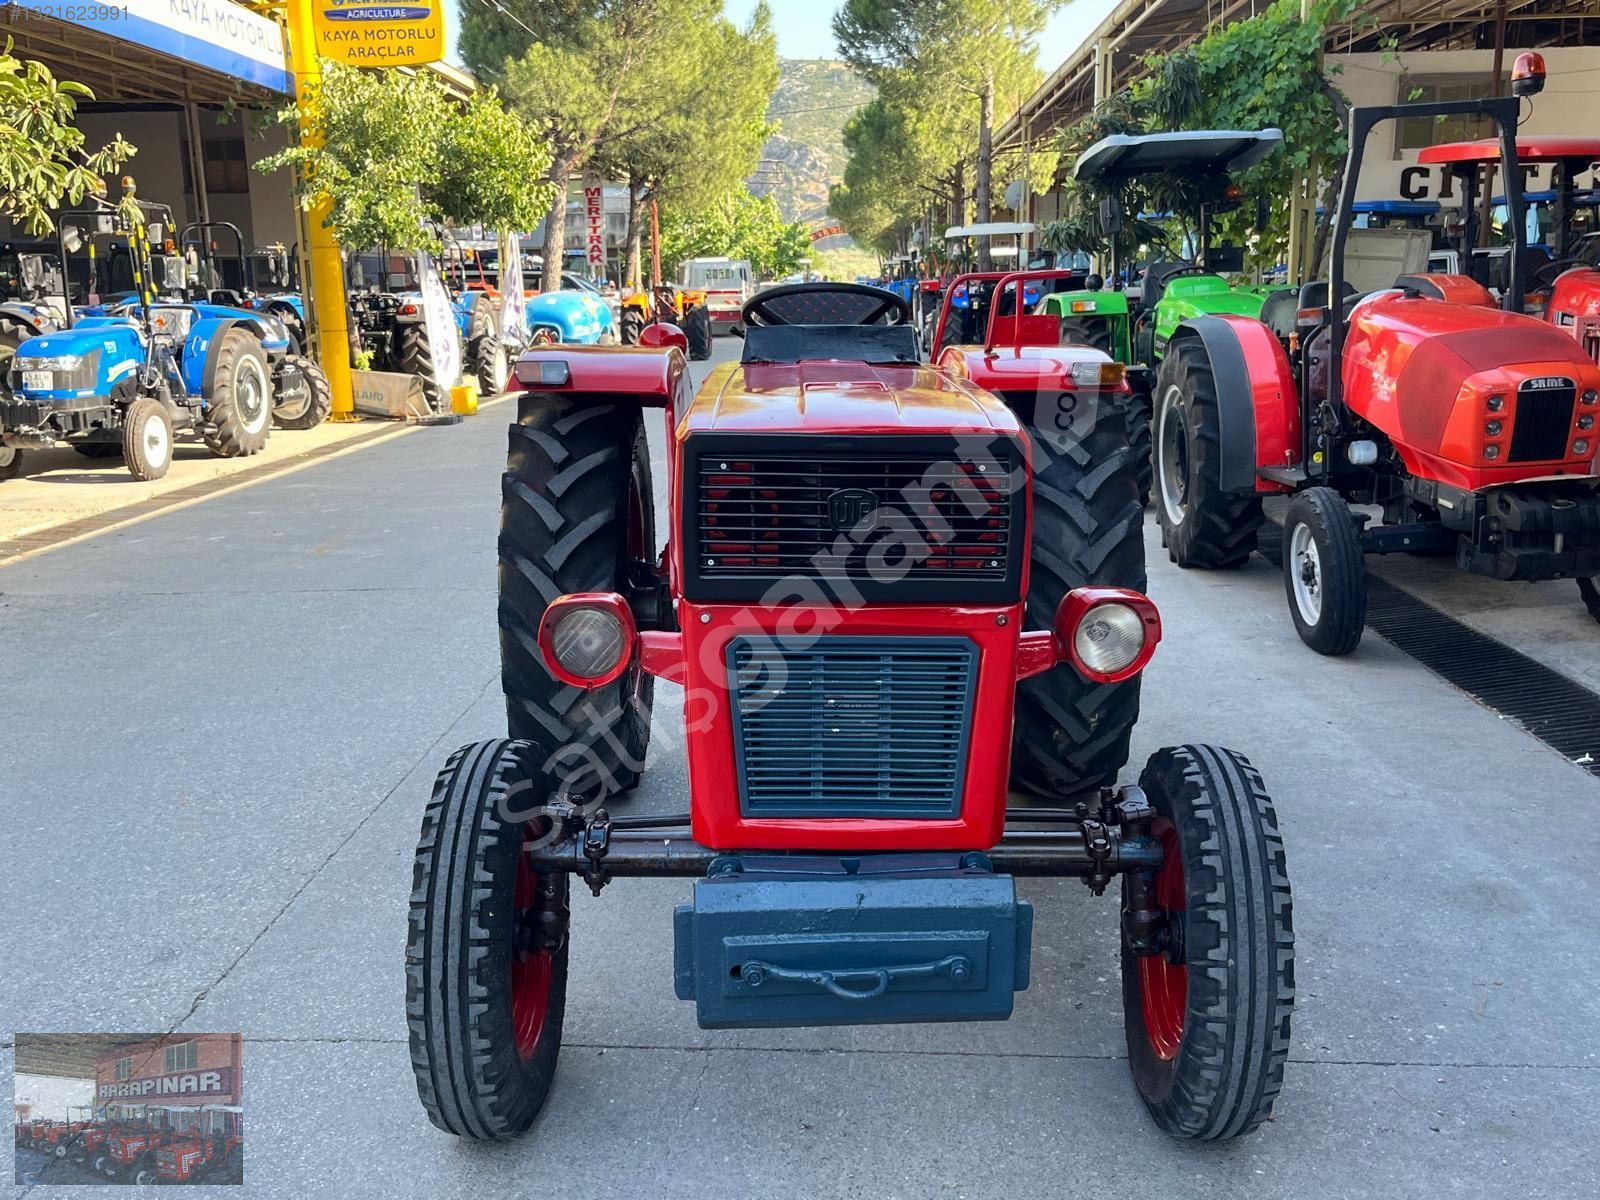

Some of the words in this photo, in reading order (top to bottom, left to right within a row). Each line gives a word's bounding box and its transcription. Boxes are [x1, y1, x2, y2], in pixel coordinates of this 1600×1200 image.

[347, 8, 406, 19] AGRICULTURE
[170, 0, 211, 28] KAYA
[215, 8, 283, 56] MOTORLU
[323, 29, 360, 42] KAYA
[364, 28, 436, 42] MOTORLU
[347, 45, 416, 60] ARAÇLAR
[584, 187, 604, 263] MERTTRAK
[1530, 377, 1565, 389] SAME
